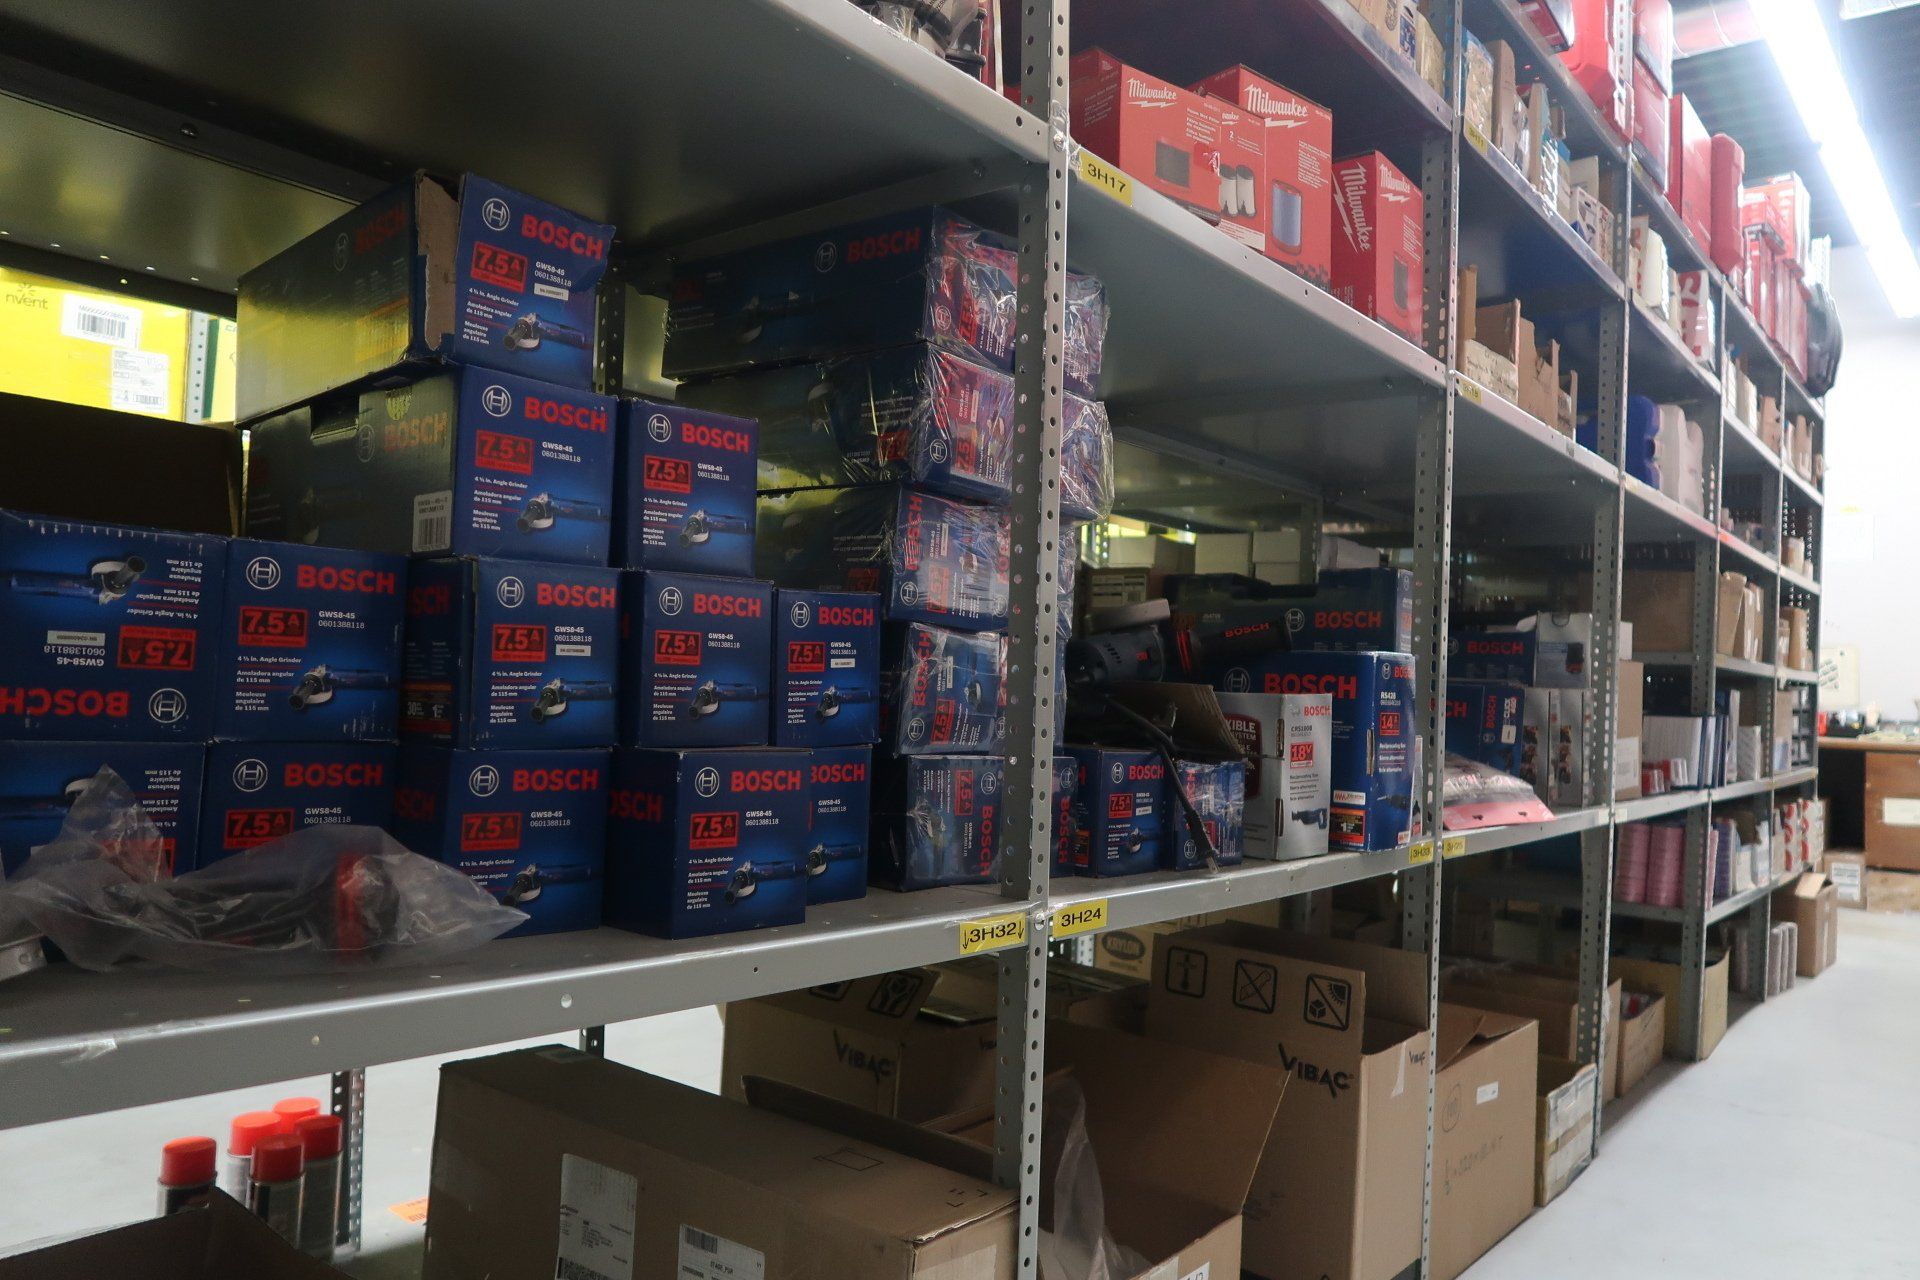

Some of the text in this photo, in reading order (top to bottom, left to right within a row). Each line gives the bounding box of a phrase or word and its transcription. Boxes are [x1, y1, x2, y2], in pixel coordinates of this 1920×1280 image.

[1128, 78, 1177, 100] Milwaukee
[1245, 84, 1308, 118] Milwaukee
[1087, 162, 1126, 193] 3H17
[1380, 163, 1410, 194] Milwaukee
[1340, 161, 1372, 252] Milwaukee
[521, 213, 604, 261] BOSCH
[846, 227, 922, 263] BOSCH
[6, 293, 48, 310] nVent
[524, 396, 609, 433] BOSCH
[383, 410, 448, 452] BOSCH
[681, 423, 750, 453] BOSCH
[542, 441, 573, 453] GWS8-45
[542, 450, 581, 463] 0601388118
[906, 495, 923, 571] BOSCH
[297, 564, 396, 595] BOSCH
[537, 582, 616, 609] BOSCH
[693, 593, 761, 618] BOSCH
[318, 620, 365, 629] 0601388118
[319, 611, 355, 619] GWS8-45
[819, 607, 874, 626] BOSCH
[1314, 611, 1383, 628] BOSCH
[554, 634, 592, 642] 0601388118
[555, 625, 585, 634] GWS8-45
[1224, 622, 1270, 638] BOSCH
[44, 645, 105, 656] 0601388118
[1466, 641, 1524, 655] BOSCH
[56, 657, 104, 667] GWS8-45
[913, 631, 934, 706] BOSCH
[1264, 673, 1357, 699] BOSCH
[0, 685, 130, 718] BOSCH
[1304, 705, 1331, 717] BOSCH
[1486, 695, 1496, 729] BOSCH
[1226, 720, 1256, 732] XIBLE
[283, 763, 384, 788] BOSCH
[512, 769, 599, 791] BOSCH
[730, 770, 801, 792] BOSCH
[1128, 765, 1164, 780] BOSCH
[304, 815, 352, 824] 0601388118
[305, 807, 342, 815] GWS8-45
[745, 818, 779, 826] 0601388118
[980, 806, 993, 876] BOSCH
[1059, 797, 1071, 863] BOSCH
[1061, 907, 1102, 927] 3H24
[969, 922, 1017, 944] 3H32
[1277, 1042, 1350, 1099] VIBAC
